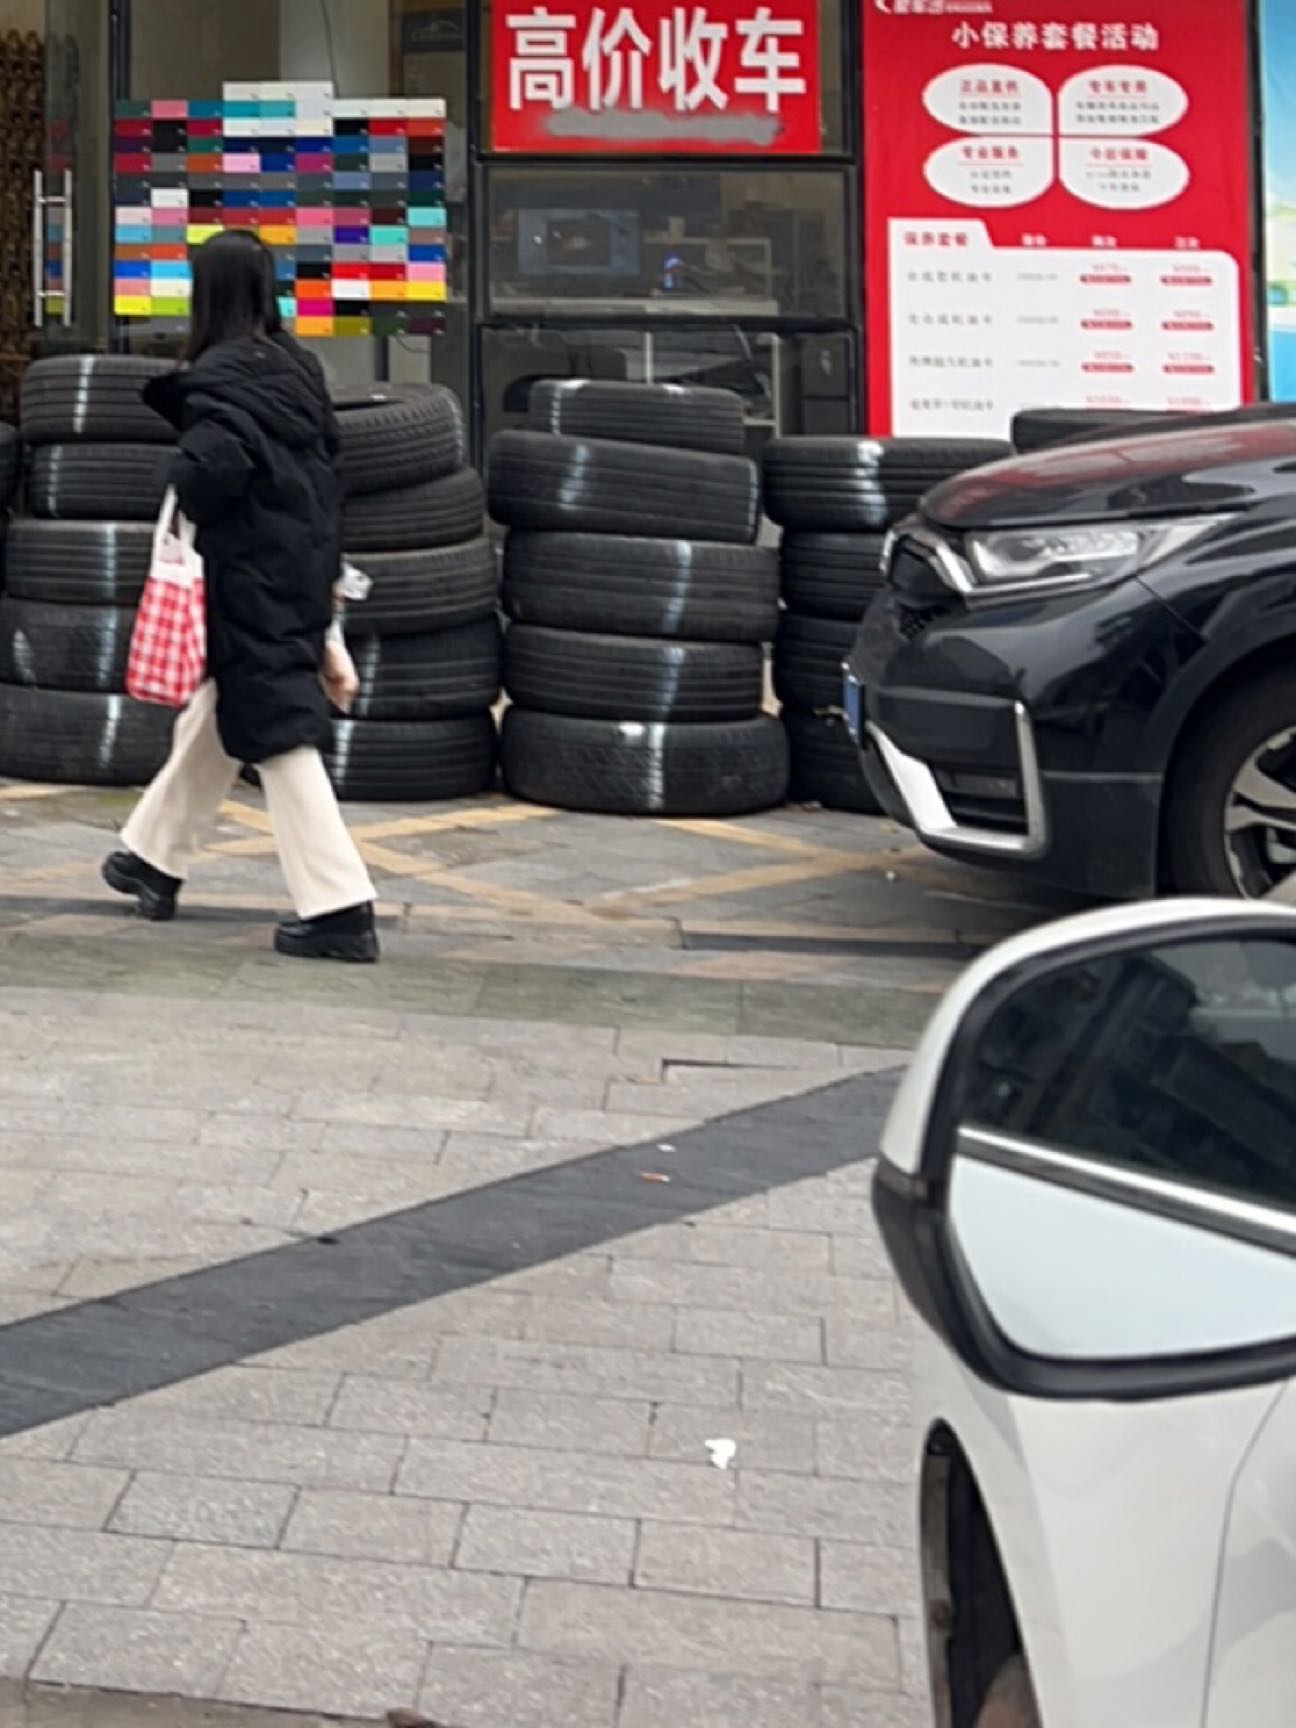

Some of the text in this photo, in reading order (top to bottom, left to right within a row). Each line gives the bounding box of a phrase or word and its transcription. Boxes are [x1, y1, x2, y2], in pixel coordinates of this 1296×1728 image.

[506, 6, 807, 113] 高价收车
[951, 21, 1159, 50] 小保养套餐活动
